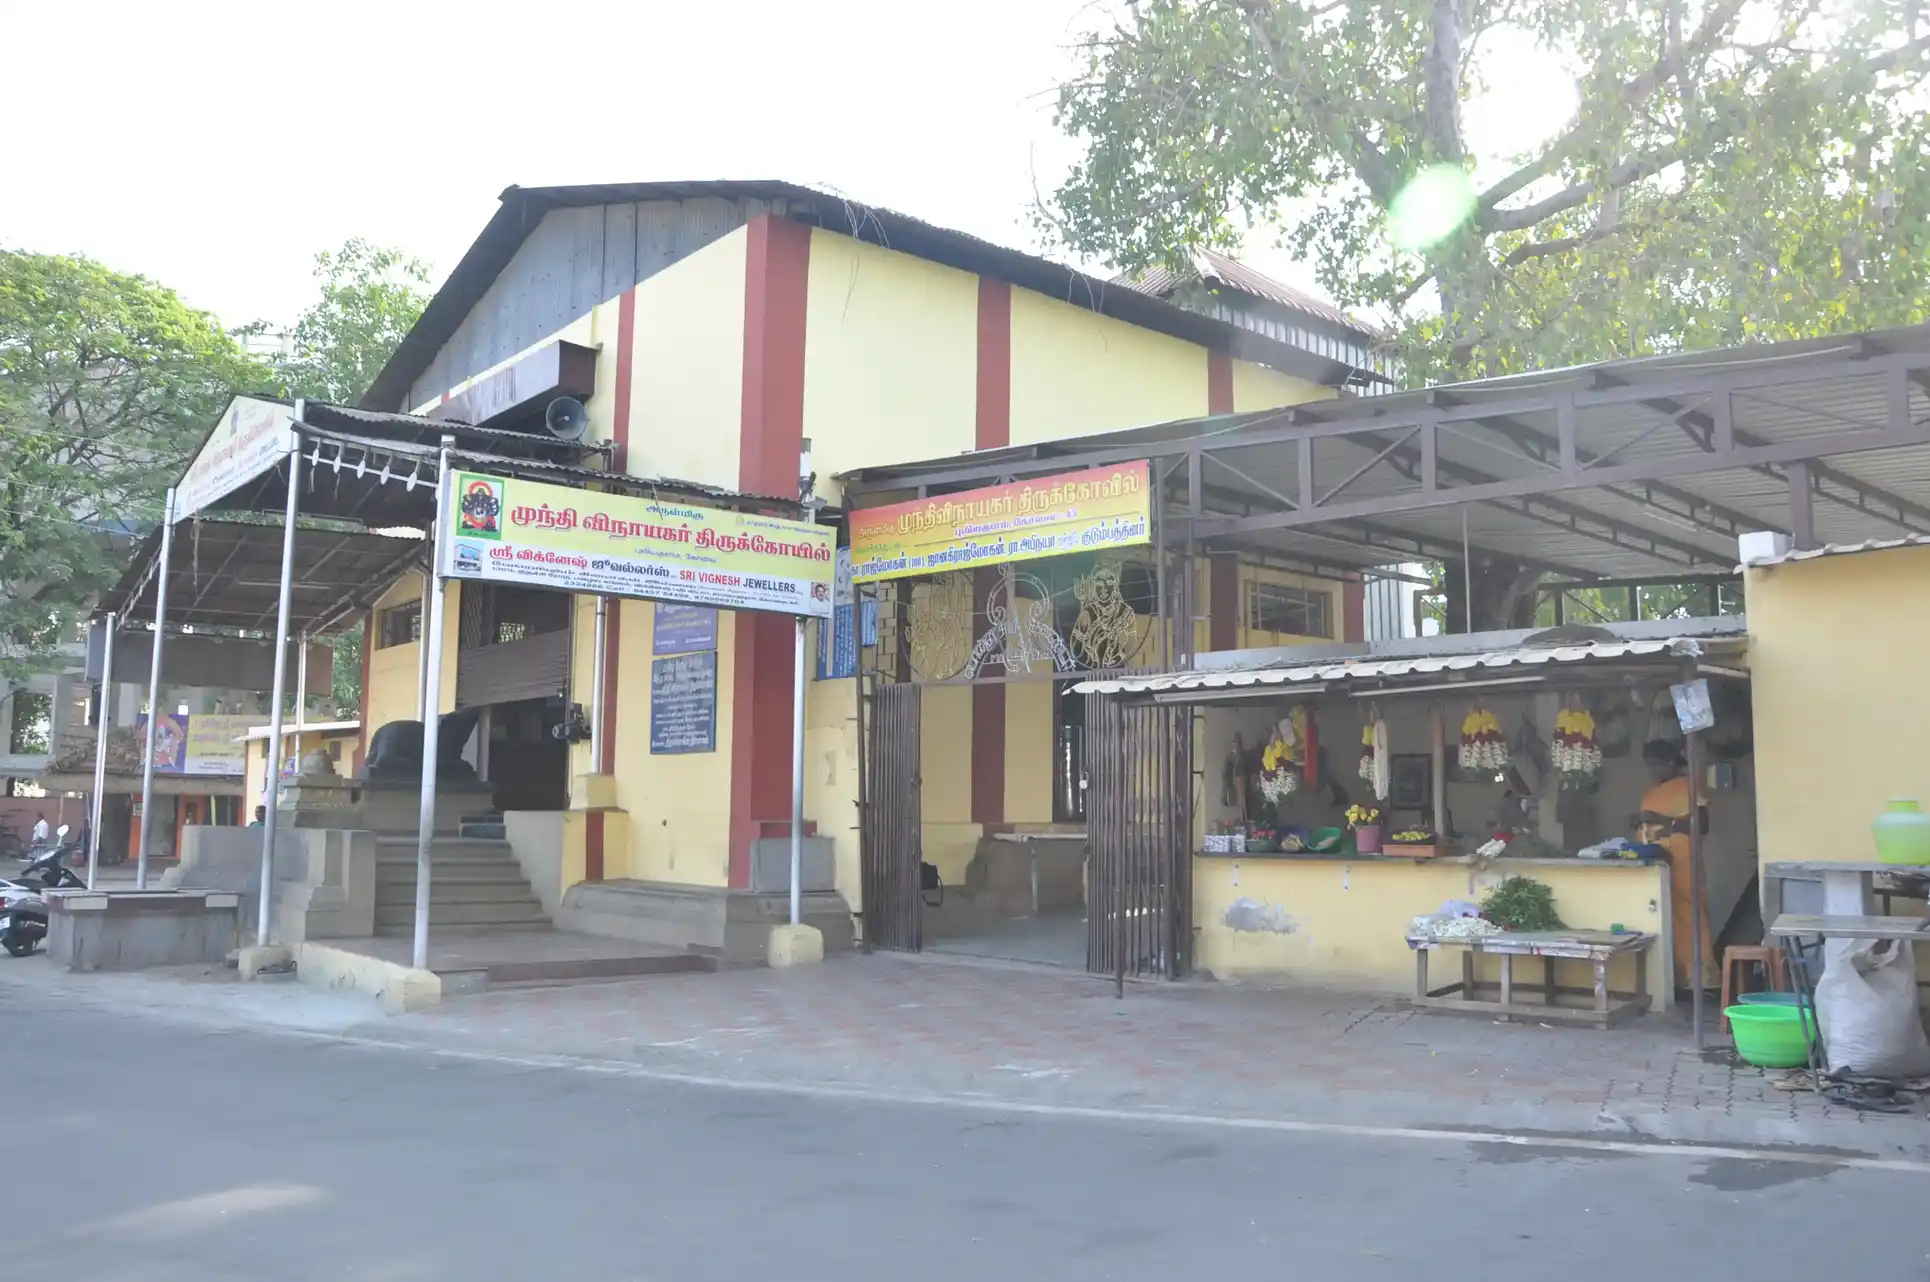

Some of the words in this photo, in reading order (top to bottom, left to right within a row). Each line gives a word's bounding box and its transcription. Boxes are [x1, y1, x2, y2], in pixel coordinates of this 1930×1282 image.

[511, 503, 578, 530] முந்தி
[582, 512, 692, 543] விநாயகர்
[695, 527, 831, 561] திருக்கோயில்
[1081, 515, 1145, 545] குடும்பத்தினர்
[489, 545, 513, 560] ஸ்ரீ
[516, 549, 588, 568] விக்னேஷ்
[679, 569, 696, 582] SRI
[698, 571, 741, 587] VIGNESH
[742, 577, 796, 593] JEWELLERS
